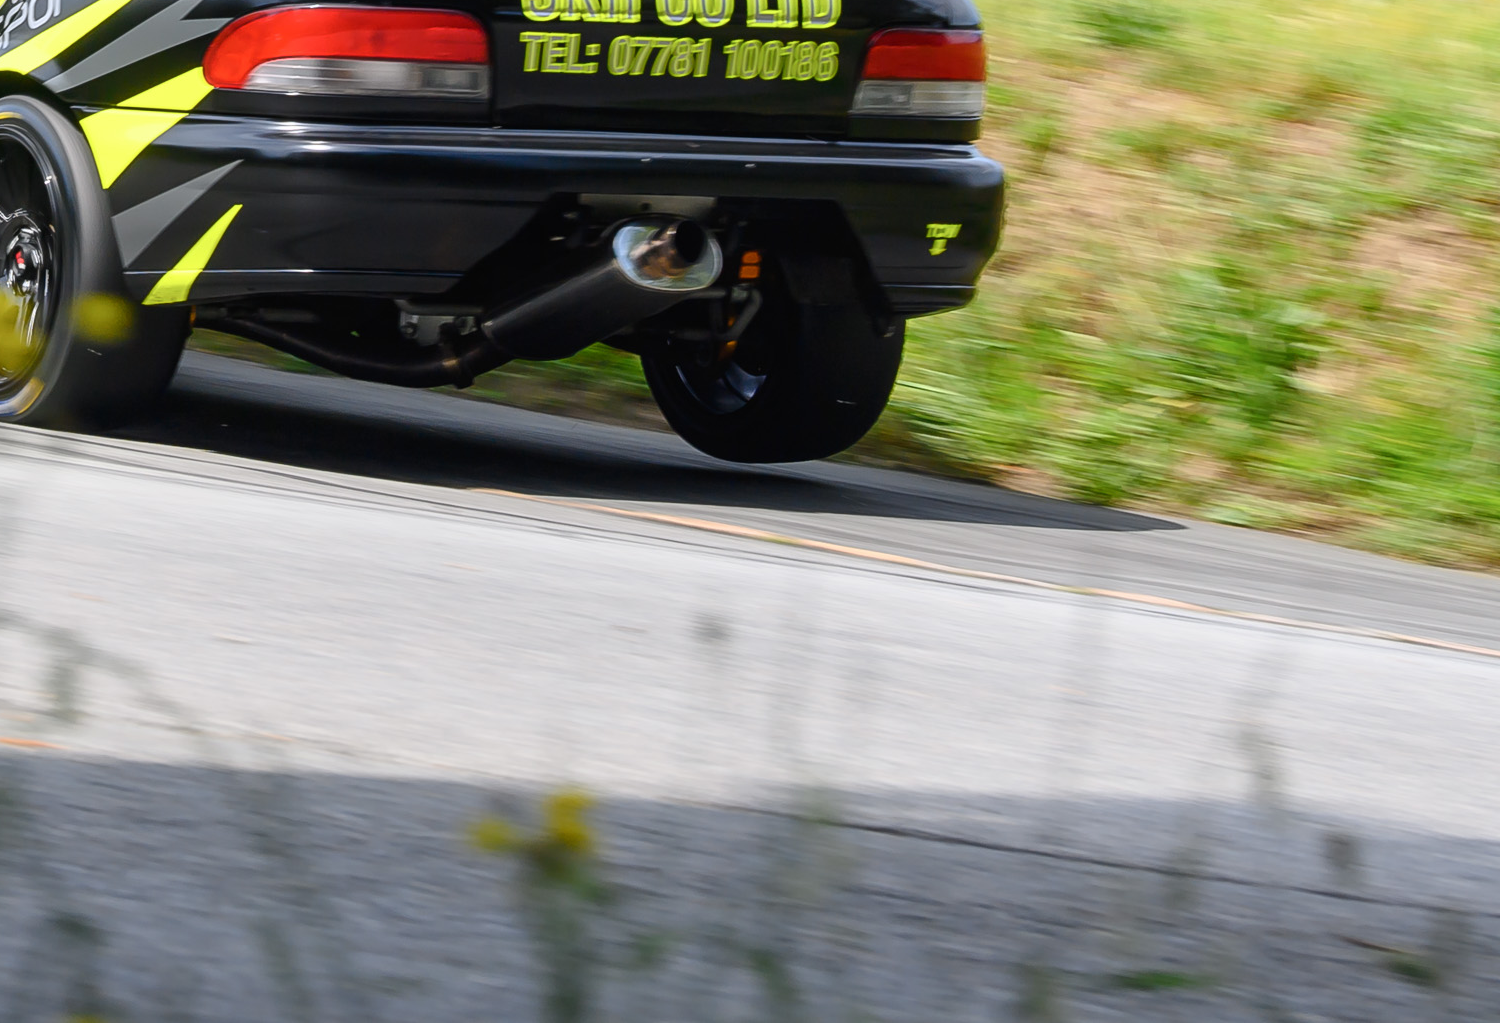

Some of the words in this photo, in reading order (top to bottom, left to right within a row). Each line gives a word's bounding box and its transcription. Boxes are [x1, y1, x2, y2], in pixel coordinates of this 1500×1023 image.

[520, 31, 601, 74] TEL:
[607, 35, 712, 78] 07781
[723, 39, 840, 82] 100186
